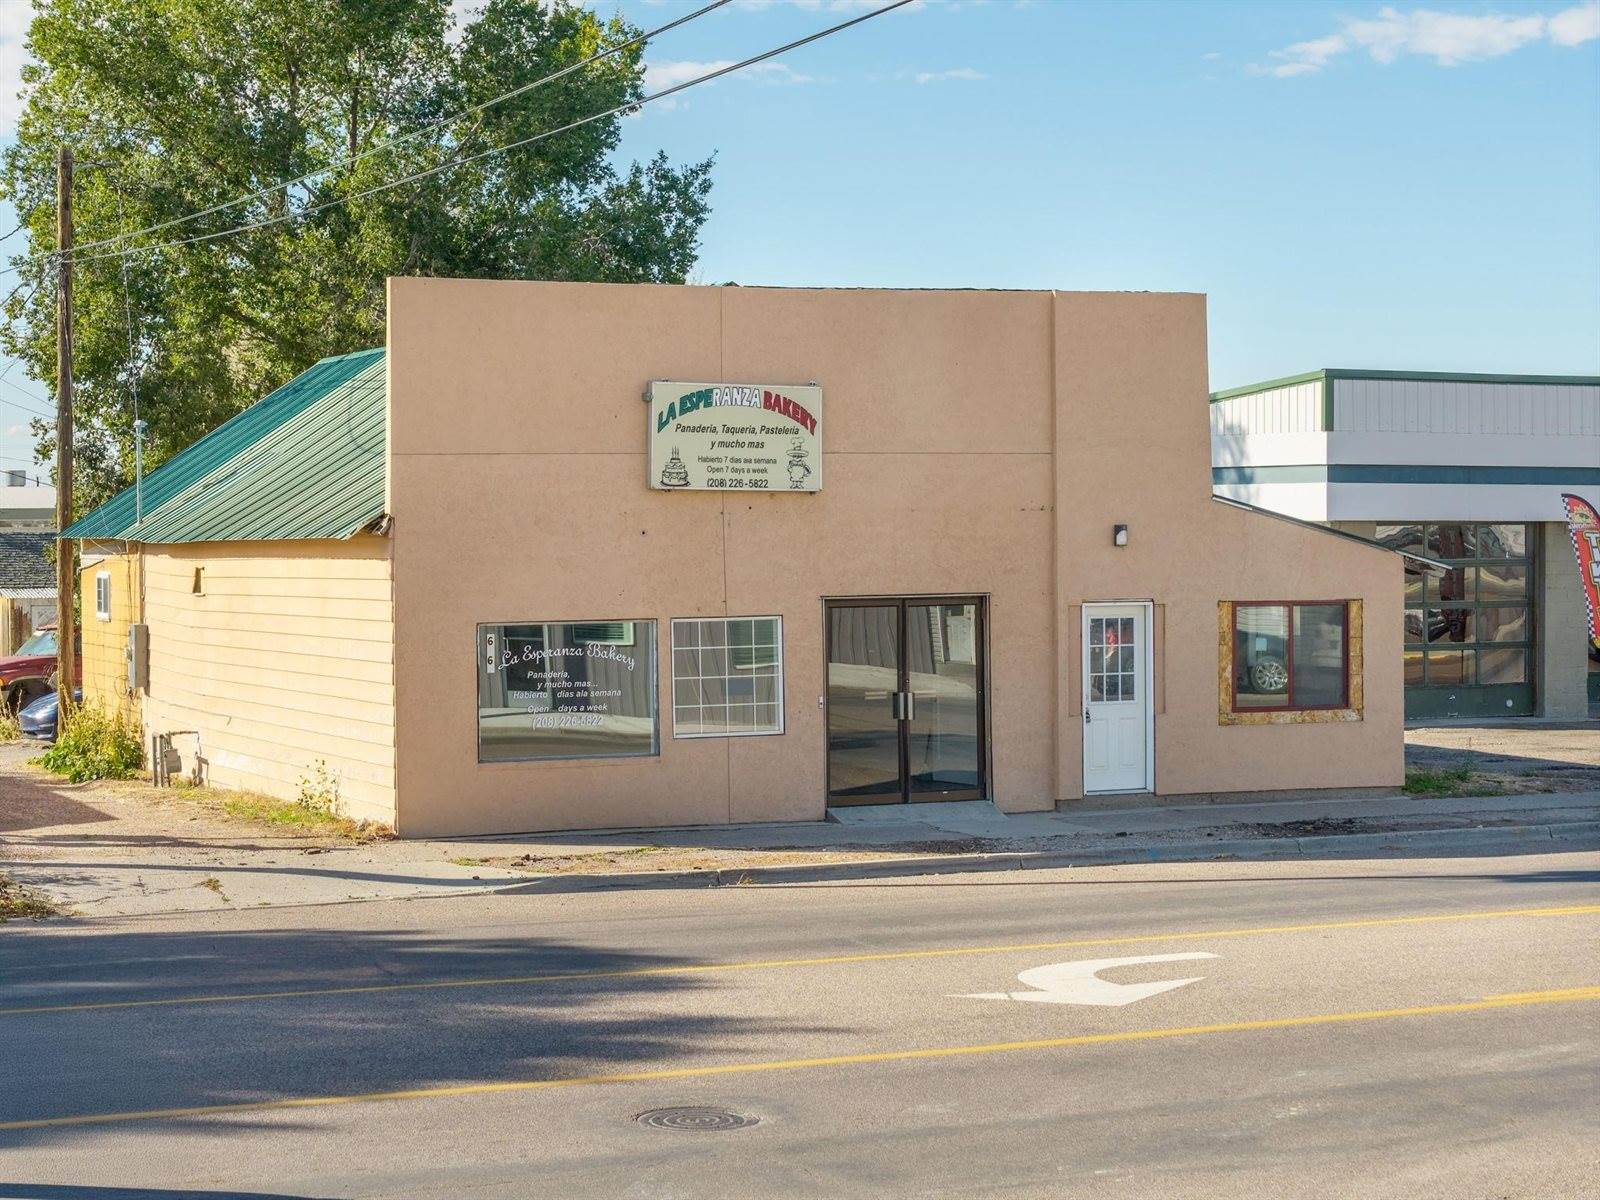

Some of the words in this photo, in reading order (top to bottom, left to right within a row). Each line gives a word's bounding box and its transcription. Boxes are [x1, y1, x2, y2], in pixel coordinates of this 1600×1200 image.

[657, 401, 677, 434] LA
[678, 386, 761, 417] ESPERANZA
[763, 390, 818, 436] BAKERY
[710, 440, 716, 450] y
[717, 439, 745, 449] mucho
[747, 441, 765, 449] mas
[706, 465, 724, 474] Open
[730, 466, 745, 475] days
[706, 478, 727, 488] (208)
[498, 650, 520, 670] La
[522, 645, 583, 664] Esperanza
[586, 640, 636, 671] Bakery
[537, 682, 542, 690] y
[544, 680, 573, 688] mucho
[513, 691, 548, 699] Habierto
[590, 689, 622, 697] semana
[527, 704, 549, 714] Open
[557, 704, 577, 714] days
[586, 703, 608, 711] week
